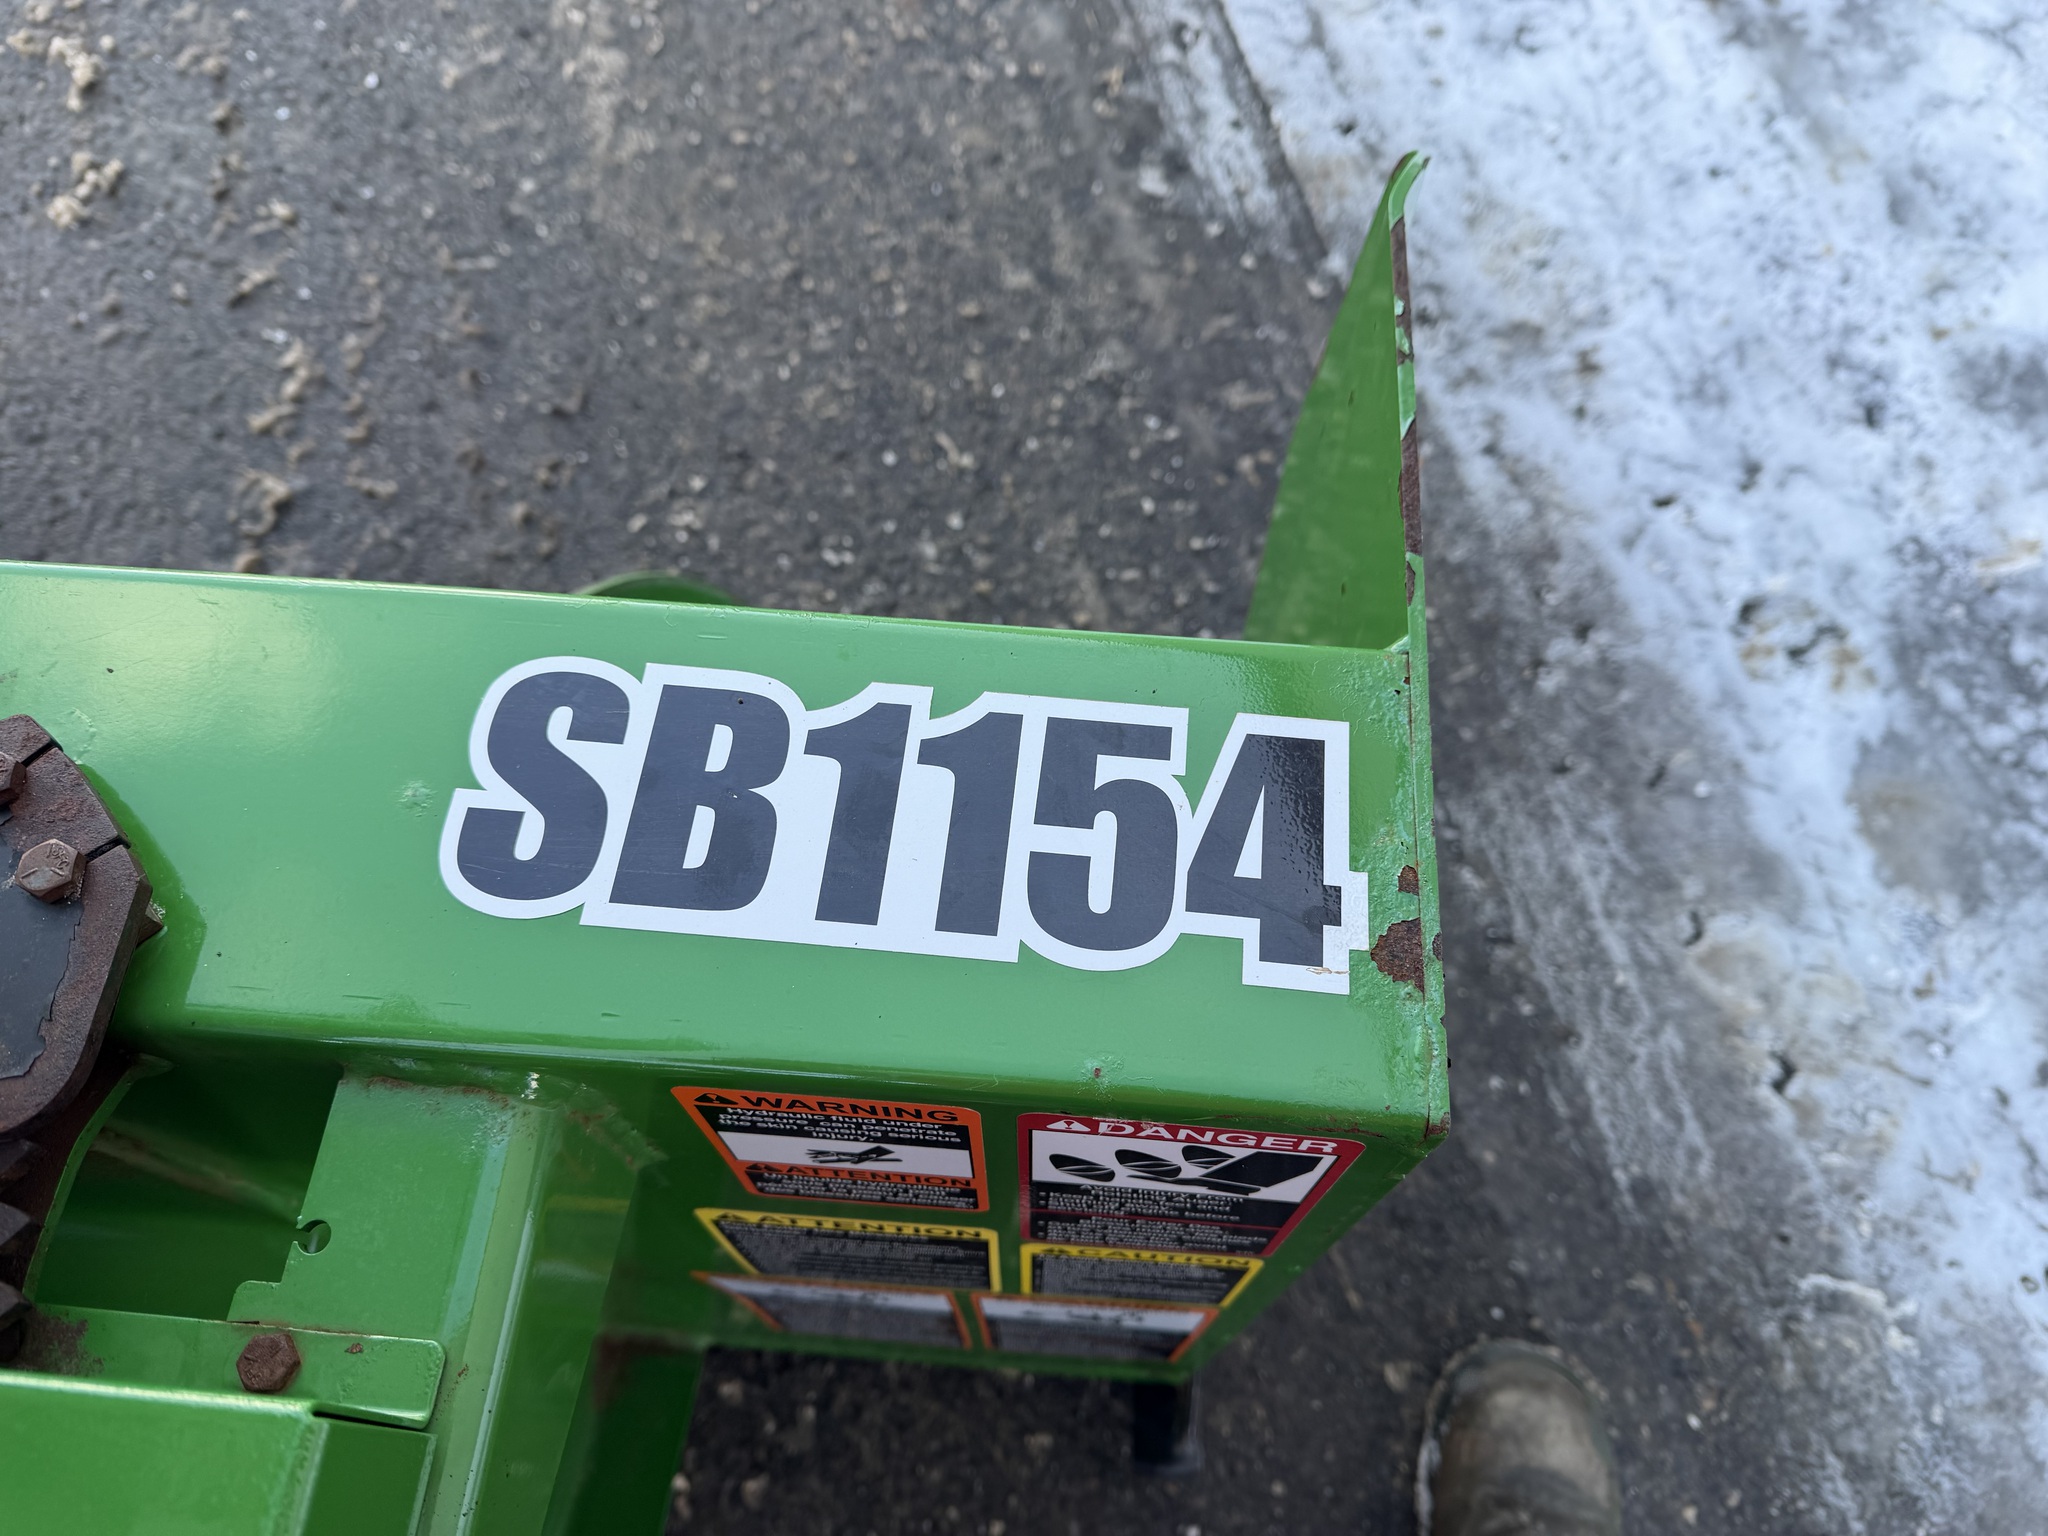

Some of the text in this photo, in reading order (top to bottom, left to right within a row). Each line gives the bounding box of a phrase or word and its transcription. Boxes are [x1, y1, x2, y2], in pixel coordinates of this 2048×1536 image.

[457, 670, 1342, 967] SB1154
[727, 1107, 941, 1128] Hydraulic fluid under
[740, 1095, 958, 1122] WARNING
[719, 1113, 808, 1124] pressure
[862, 1124, 957, 1135] penetrate
[756, 1121, 797, 1129] skin
[804, 1125, 881, 1136] causing
[888, 1131, 961, 1142] serious
[1098, 1121, 1337, 1153] DANGER
[786, 1165, 970, 1186] ATTENTION
[758, 1215, 980, 1237] ATTENTION
[1078, 1247, 1249, 1267] CAUTION
